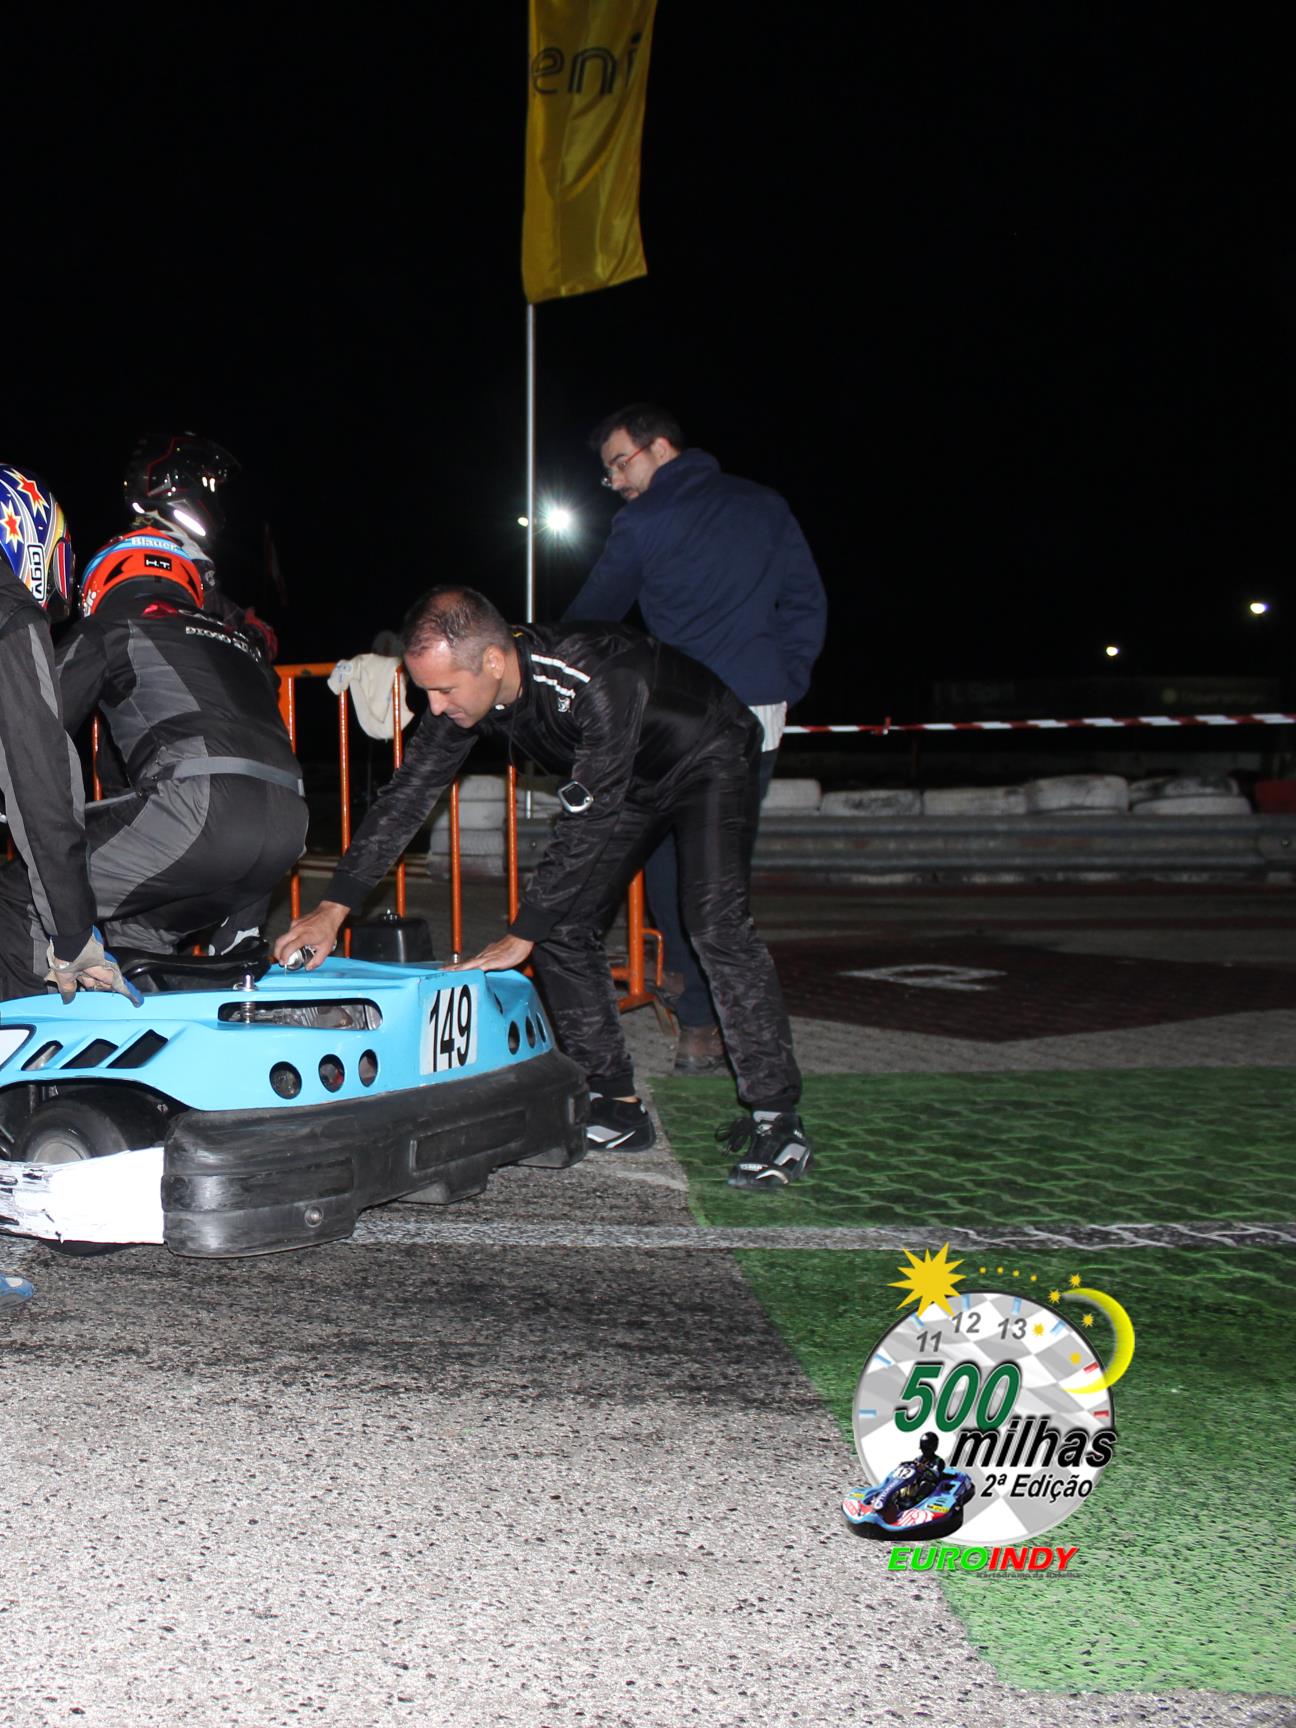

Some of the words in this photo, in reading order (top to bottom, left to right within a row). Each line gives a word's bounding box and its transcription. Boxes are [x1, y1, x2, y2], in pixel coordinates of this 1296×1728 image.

[531, 32, 642, 95] eni
[31, 551, 43, 594] agv
[429, 984, 472, 1073] 149
